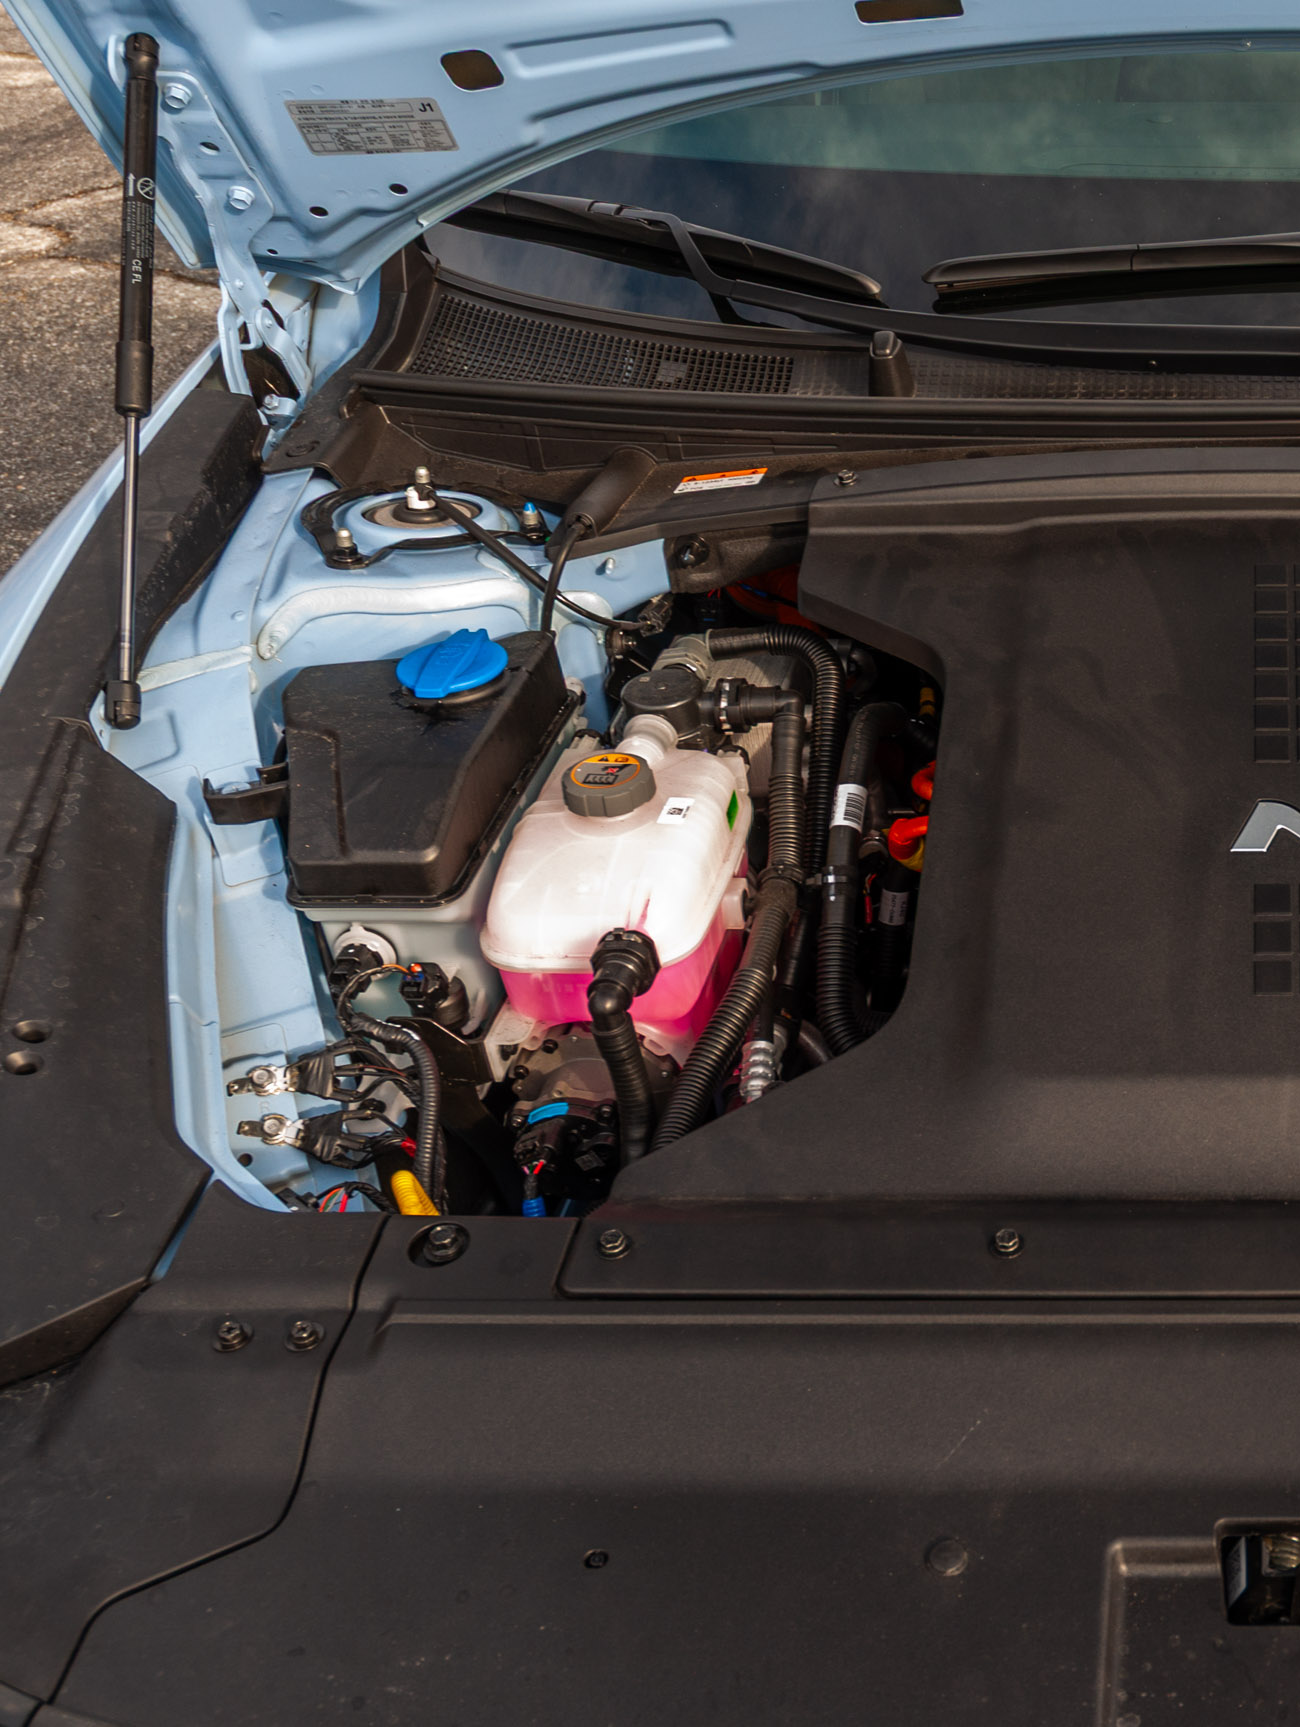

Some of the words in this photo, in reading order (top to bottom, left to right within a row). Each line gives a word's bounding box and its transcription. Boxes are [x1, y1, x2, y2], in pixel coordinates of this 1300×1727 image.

[418, 102, 434, 112] J1
[132, 259, 143, 272] CE
[131, 273, 143, 284] FL
